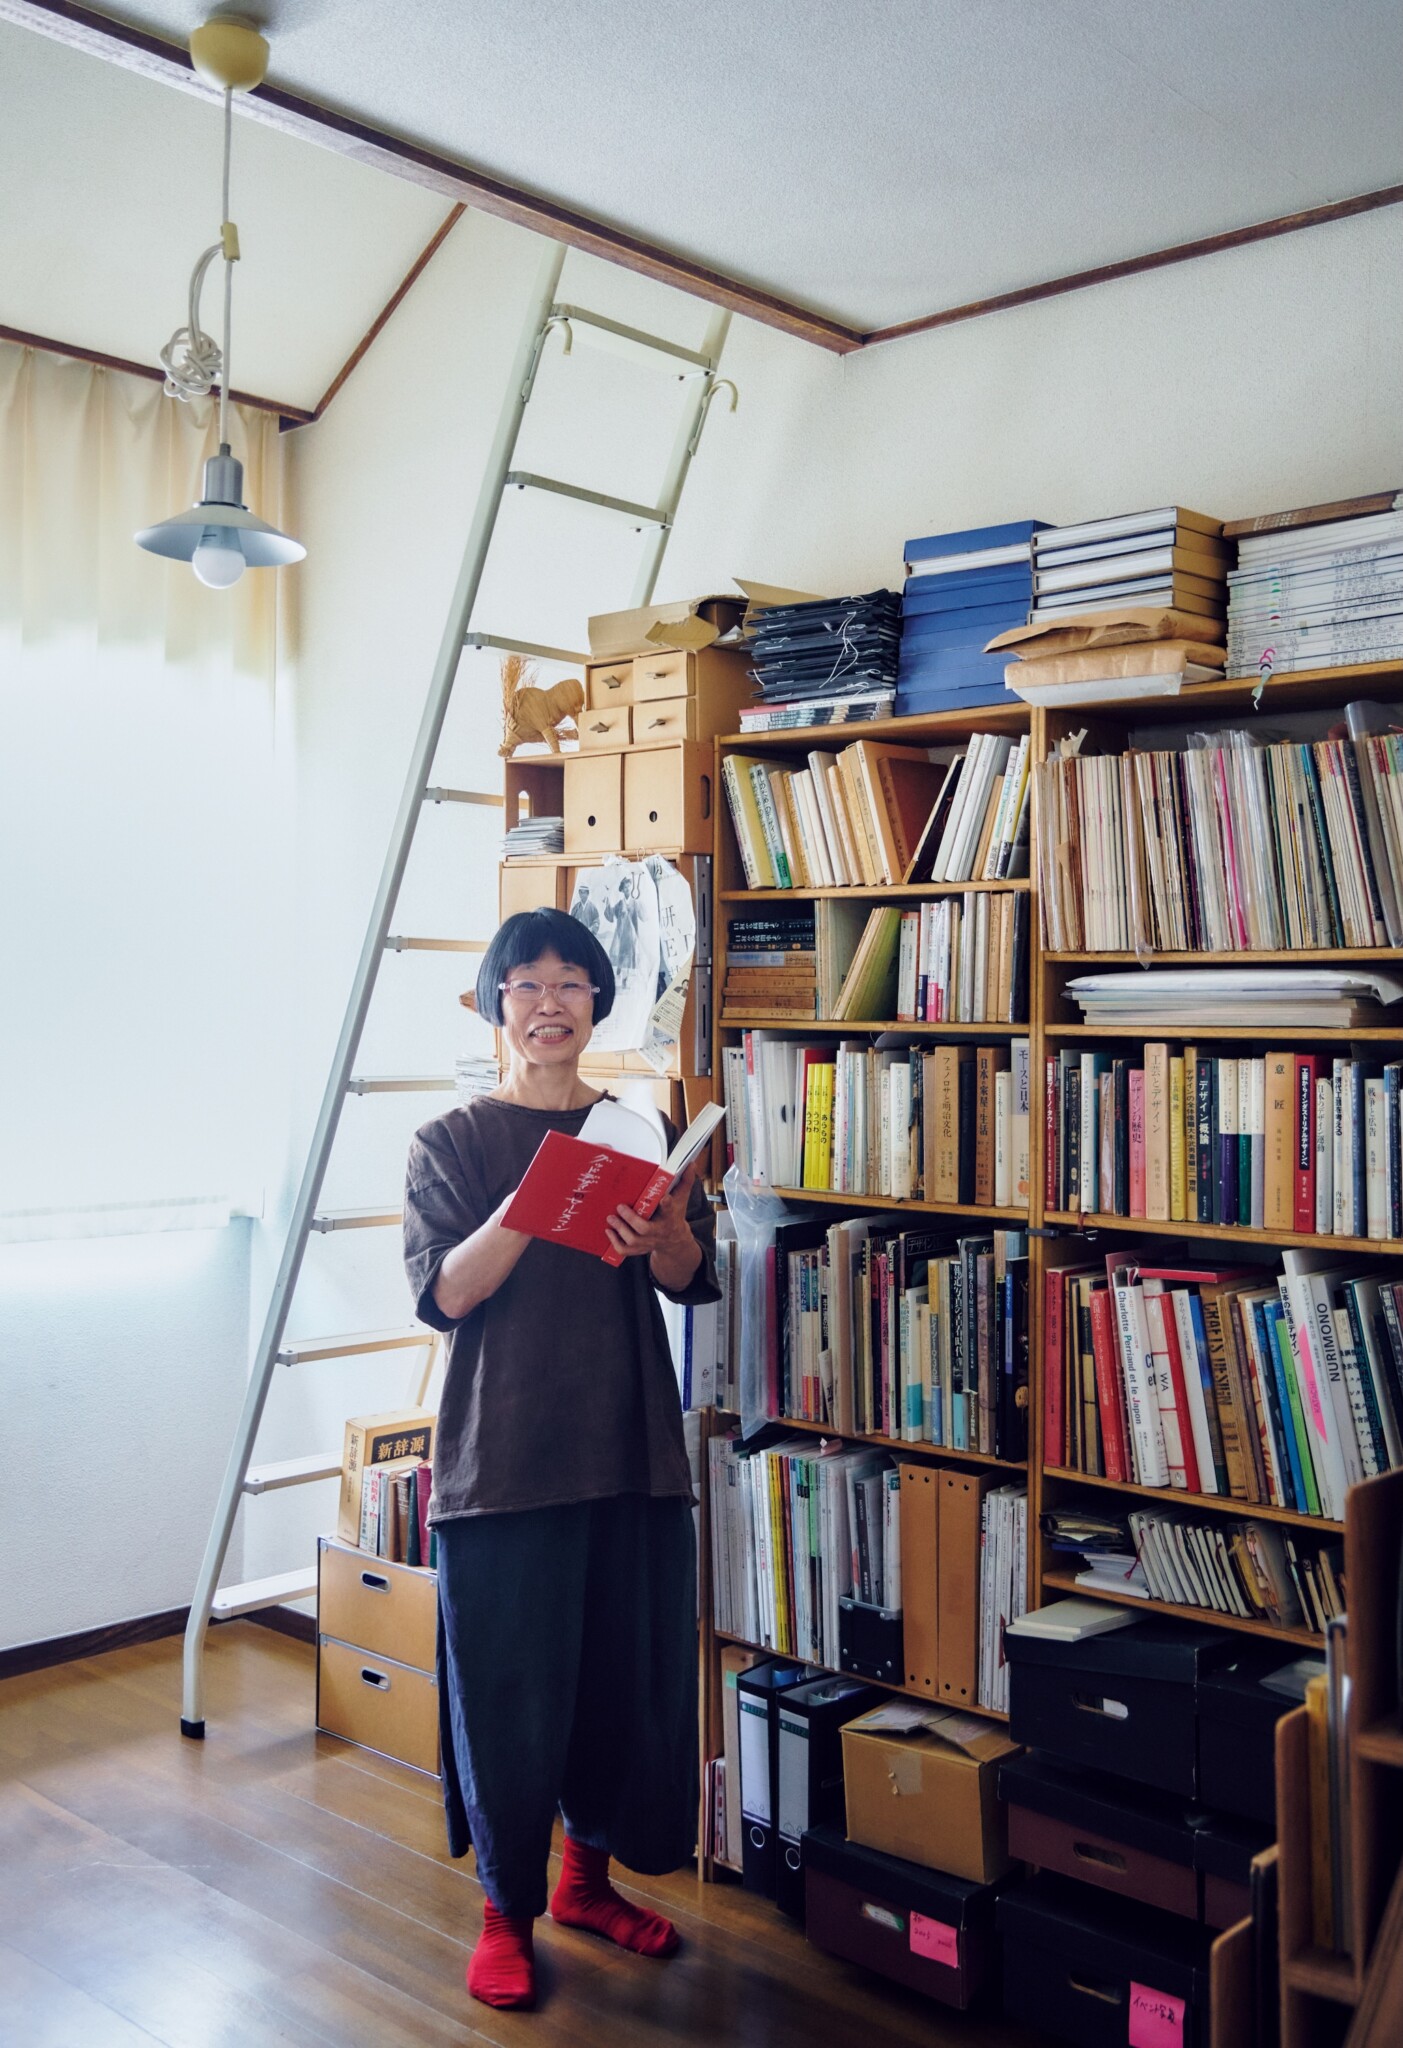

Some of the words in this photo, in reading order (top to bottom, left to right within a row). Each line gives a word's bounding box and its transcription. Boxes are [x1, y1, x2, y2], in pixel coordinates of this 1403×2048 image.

[943, 1057, 952, 1138] フェノロサと明治文化
[980, 1058, 989, 1136] 日本の家屋と生活
[1019, 1050, 1029, 1112] モースと日本
[1132, 1076, 1143, 1144] デザインの歴史
[1151, 1054, 1162, 1134] 工芸とデザイン
[1367, 1087, 1376, 1137] 戦争と広告
[1198, 1080, 1210, 1145] デザイン概論
[1301, 1066, 1309, 1167] 工芸からインダストリアルデザインへ
[1317, 1084, 1325, 1153] 日本のデザイン運動
[1117, 1291, 1129, 1333] Charlotte
[1280, 1286, 1300, 1357] 日本の生活デザイン
[1317, 1302, 1341, 1382] NURIMONO
[1124, 1334, 1136, 1373] Perriand
[1130, 1373, 1137, 1384] et
[1159, 1372, 1169, 1393] WA
[1130, 1386, 1138, 1395] le
[1132, 1397, 1142, 1426] Japon
[1309, 1381, 1320, 1414] KATACHI
[377, 1435, 425, 1461] 新辞源
